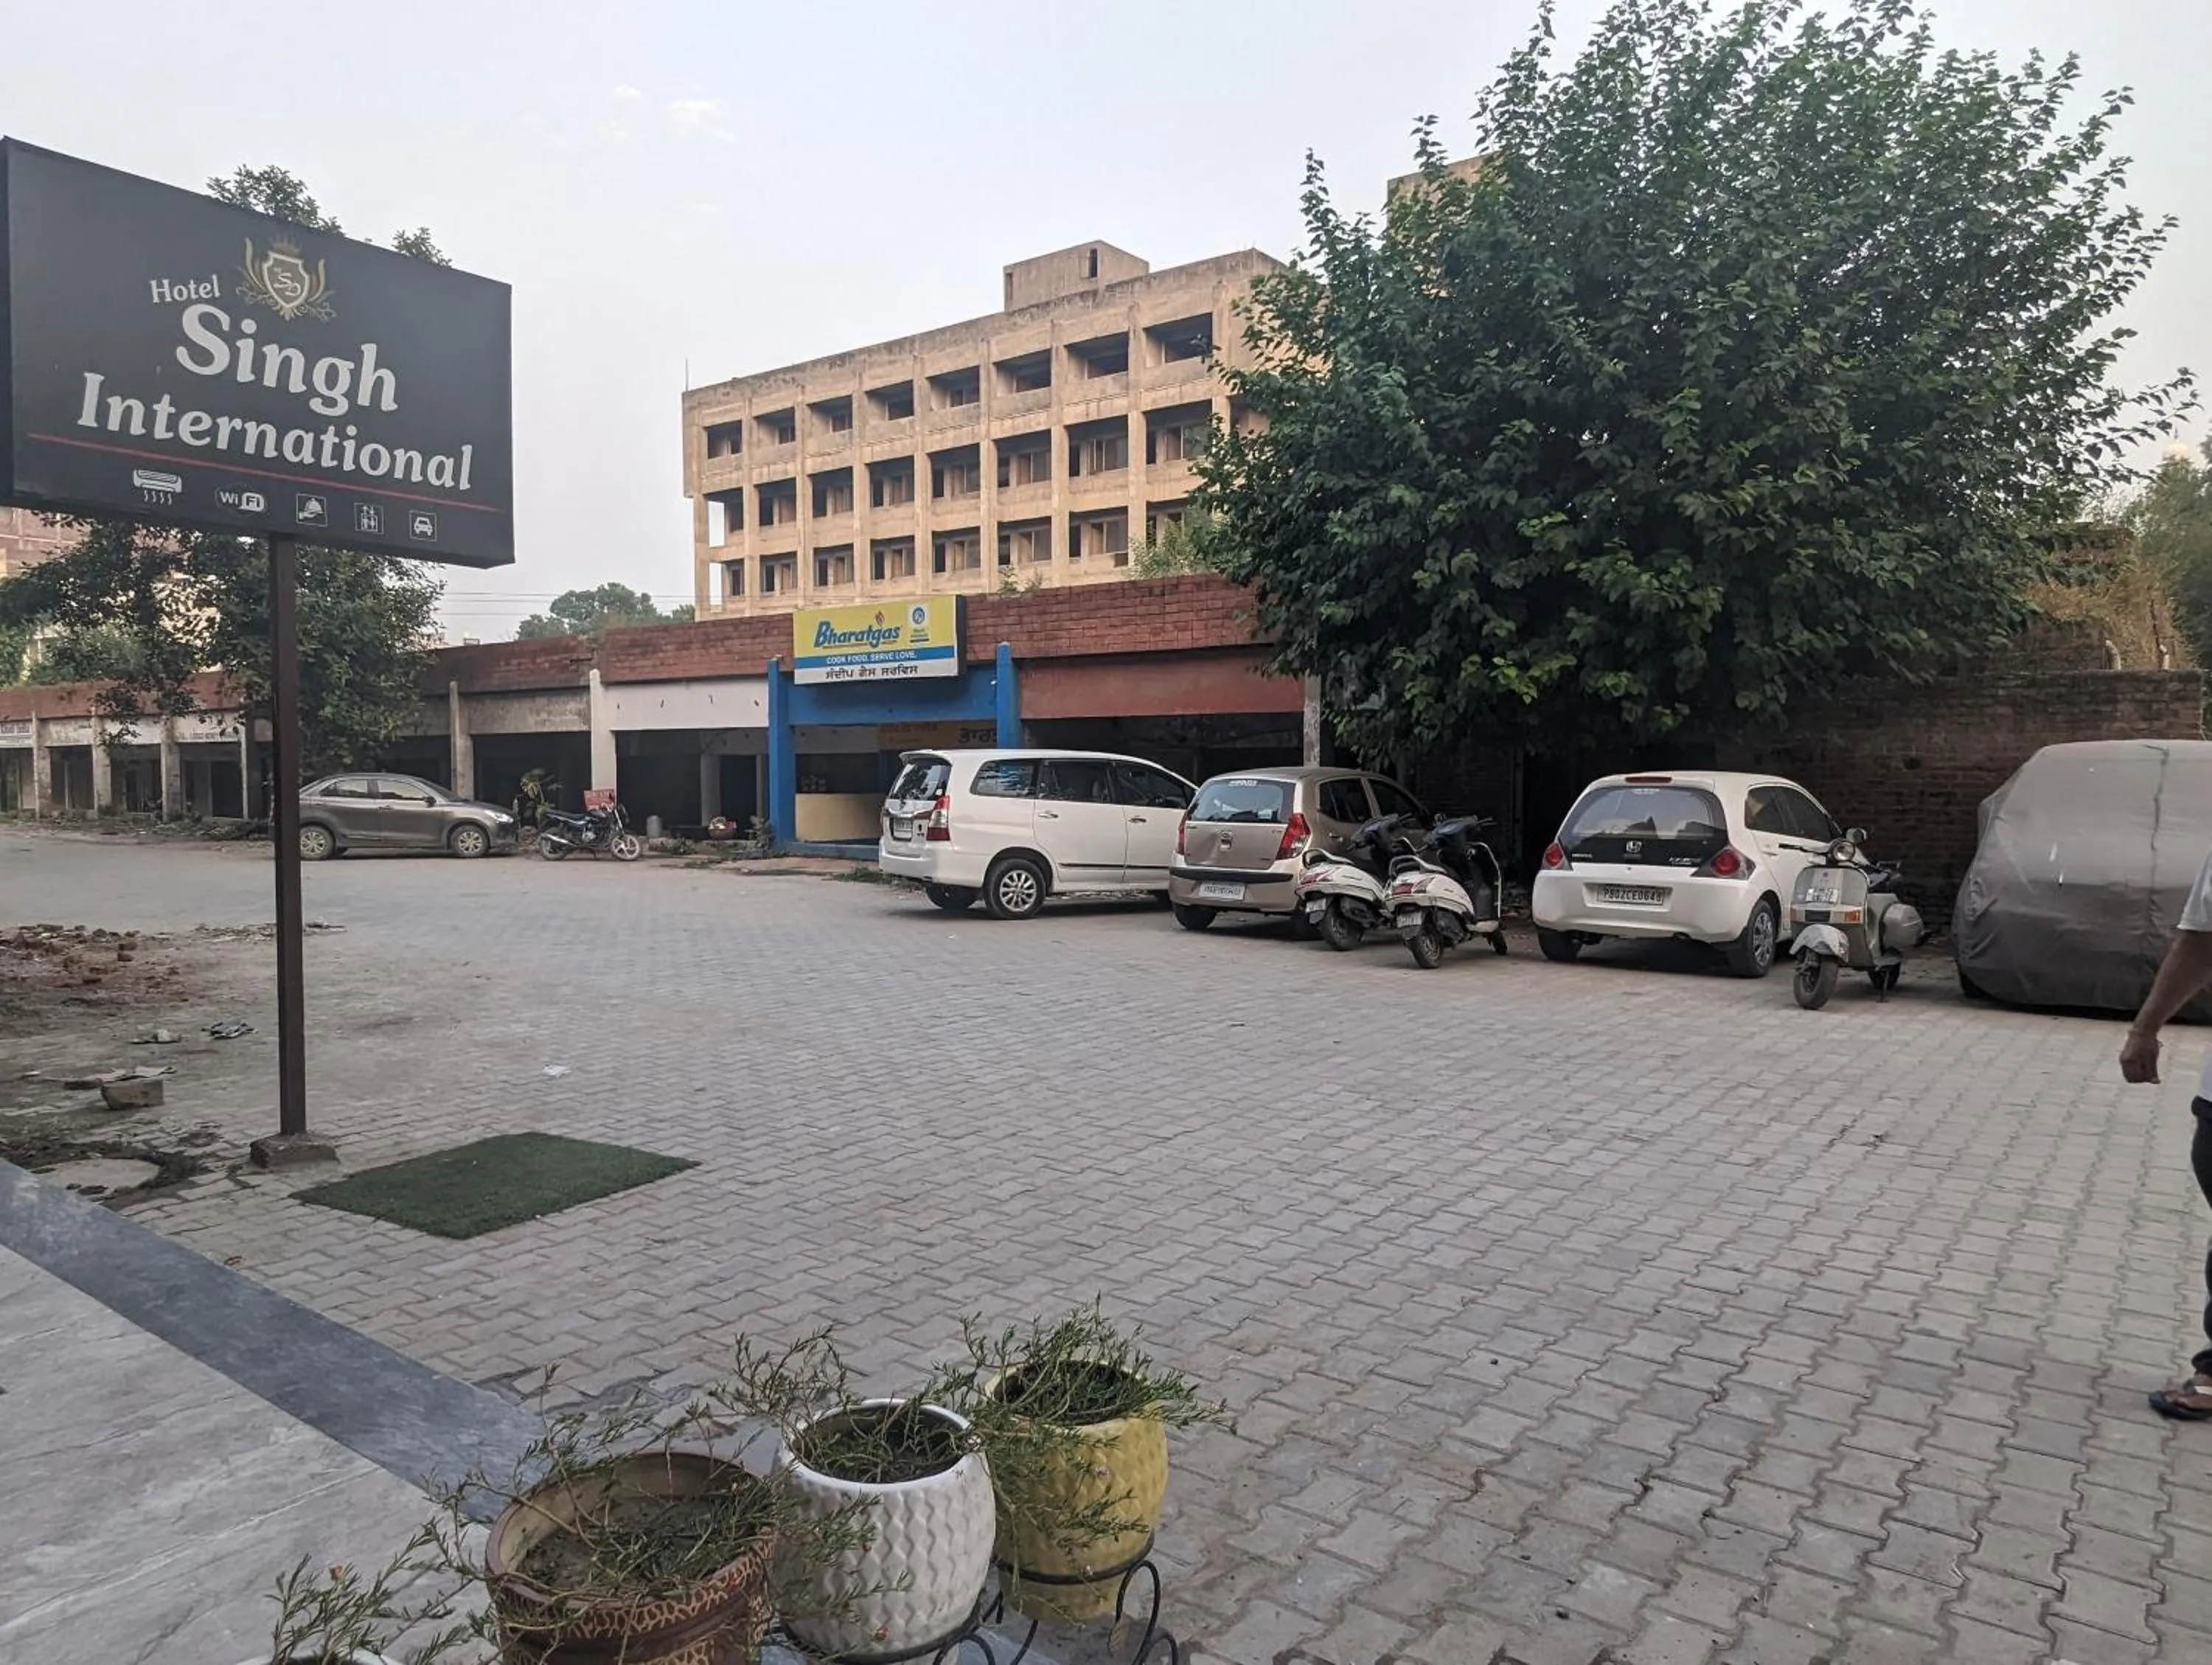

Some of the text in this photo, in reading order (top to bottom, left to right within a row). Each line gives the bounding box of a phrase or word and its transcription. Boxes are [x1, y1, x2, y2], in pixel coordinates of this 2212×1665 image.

[150, 274, 220, 303] Hotel
[176, 303, 397, 416] Singh
[77, 372, 472, 490] International
[813, 620, 901, 648] Bharatgas
